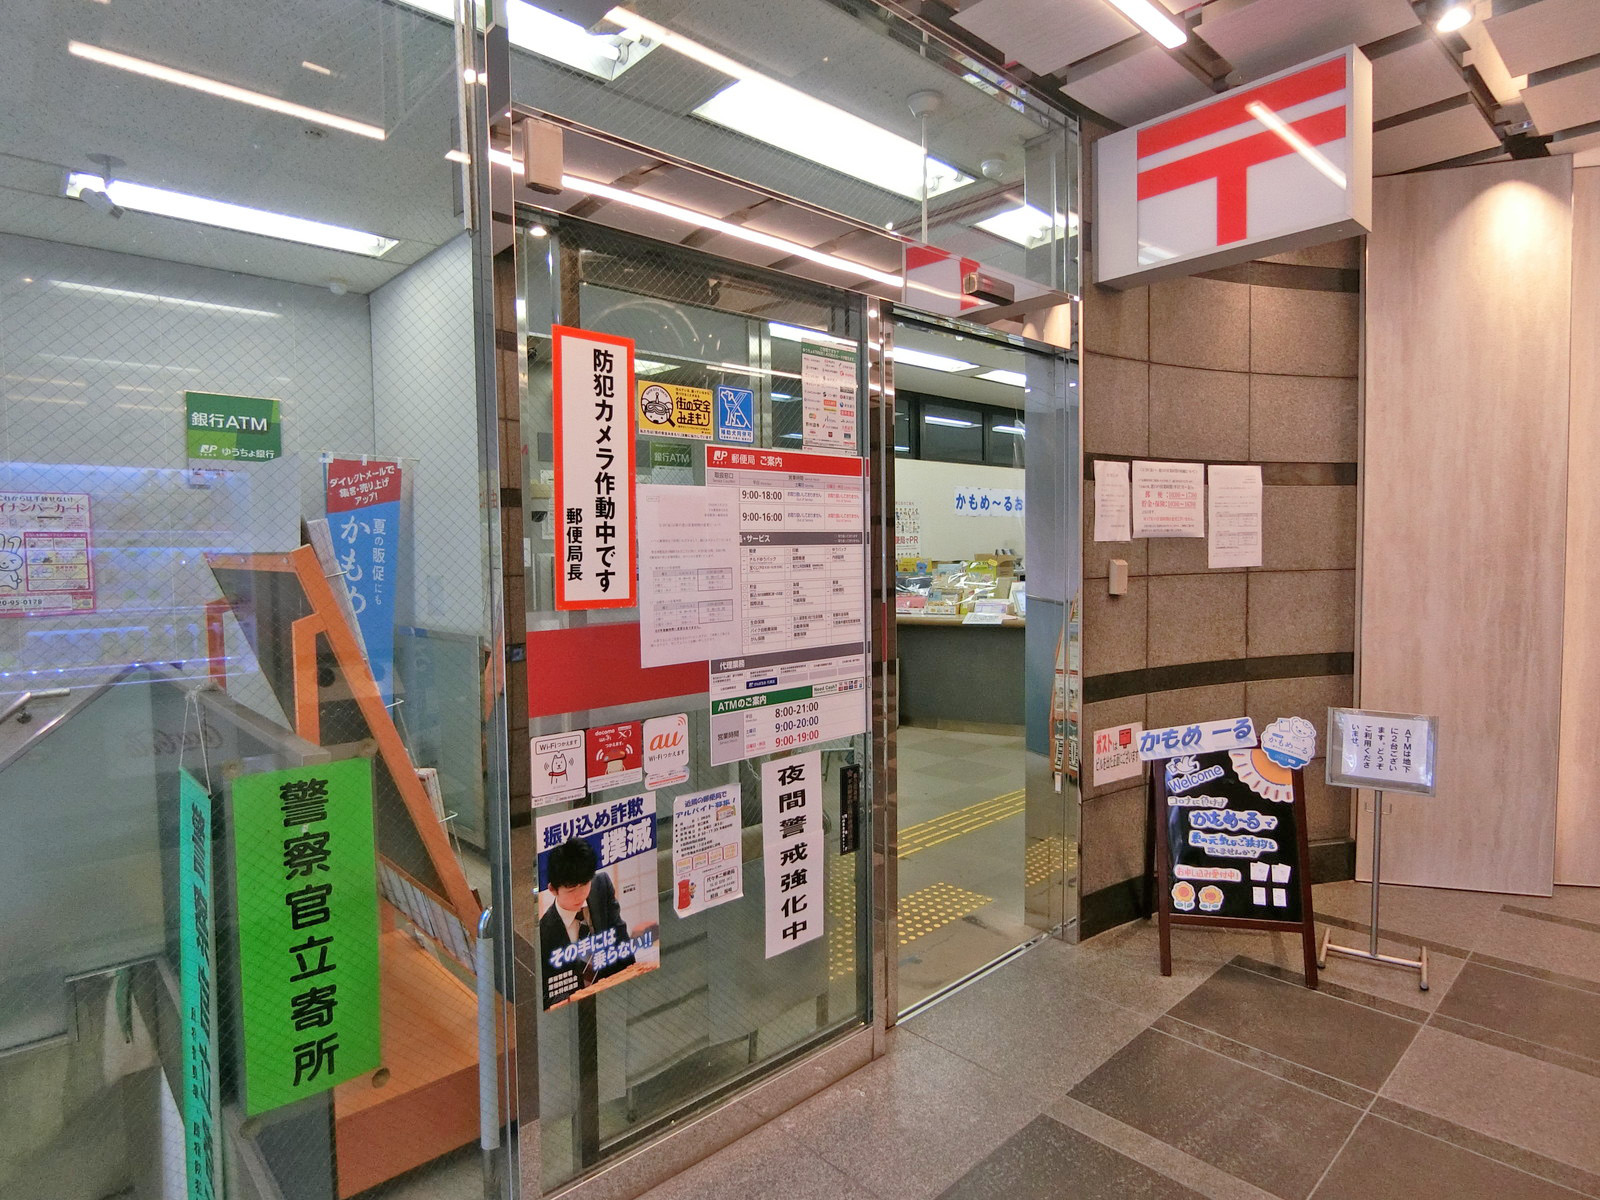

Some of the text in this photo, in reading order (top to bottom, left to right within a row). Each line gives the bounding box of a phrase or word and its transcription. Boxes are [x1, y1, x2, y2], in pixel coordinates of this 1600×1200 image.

[676, 396, 711, 412] 街の安全
[191, 411, 268, 432] 銀行ATM
[676, 411, 711, 427] みまもり
[221, 447, 275, 459] ゆうちょ銀行
[731, 454, 783, 467] 郵便局 ご案内
[329, 464, 396, 488] ダイレクトメールで
[592, 348, 617, 593] 防犯カメラ作動中です
[741, 490, 783, 501] 9:00-18:00
[742, 512, 783, 523] 9:00-16:00
[566, 507, 584, 581] 郵便局長
[372, 518, 387, 606] 夏の販促にも
[718, 695, 767, 712] ATMのご案内
[775, 702, 819, 718] 8:00-21:00
[775, 716, 819, 733] 9:00-20:00
[1140, 718, 1252, 752] かもめーる
[650, 731, 683, 751] au
[775, 730, 819, 747] 9:00-19:00
[1402, 728, 1412, 773] ATMは地下
[1168, 765, 1223, 793] Welcome
[684, 791, 727, 807] 近隣の郵便局で
[544, 797, 644, 849] 振り込め詐欺
[600, 817, 652, 866] 撲滅
[777, 763, 808, 940] 夜間警戒強化中
[279, 778, 339, 1087] 警察官立寄所
[549, 927, 616, 968] その手には
